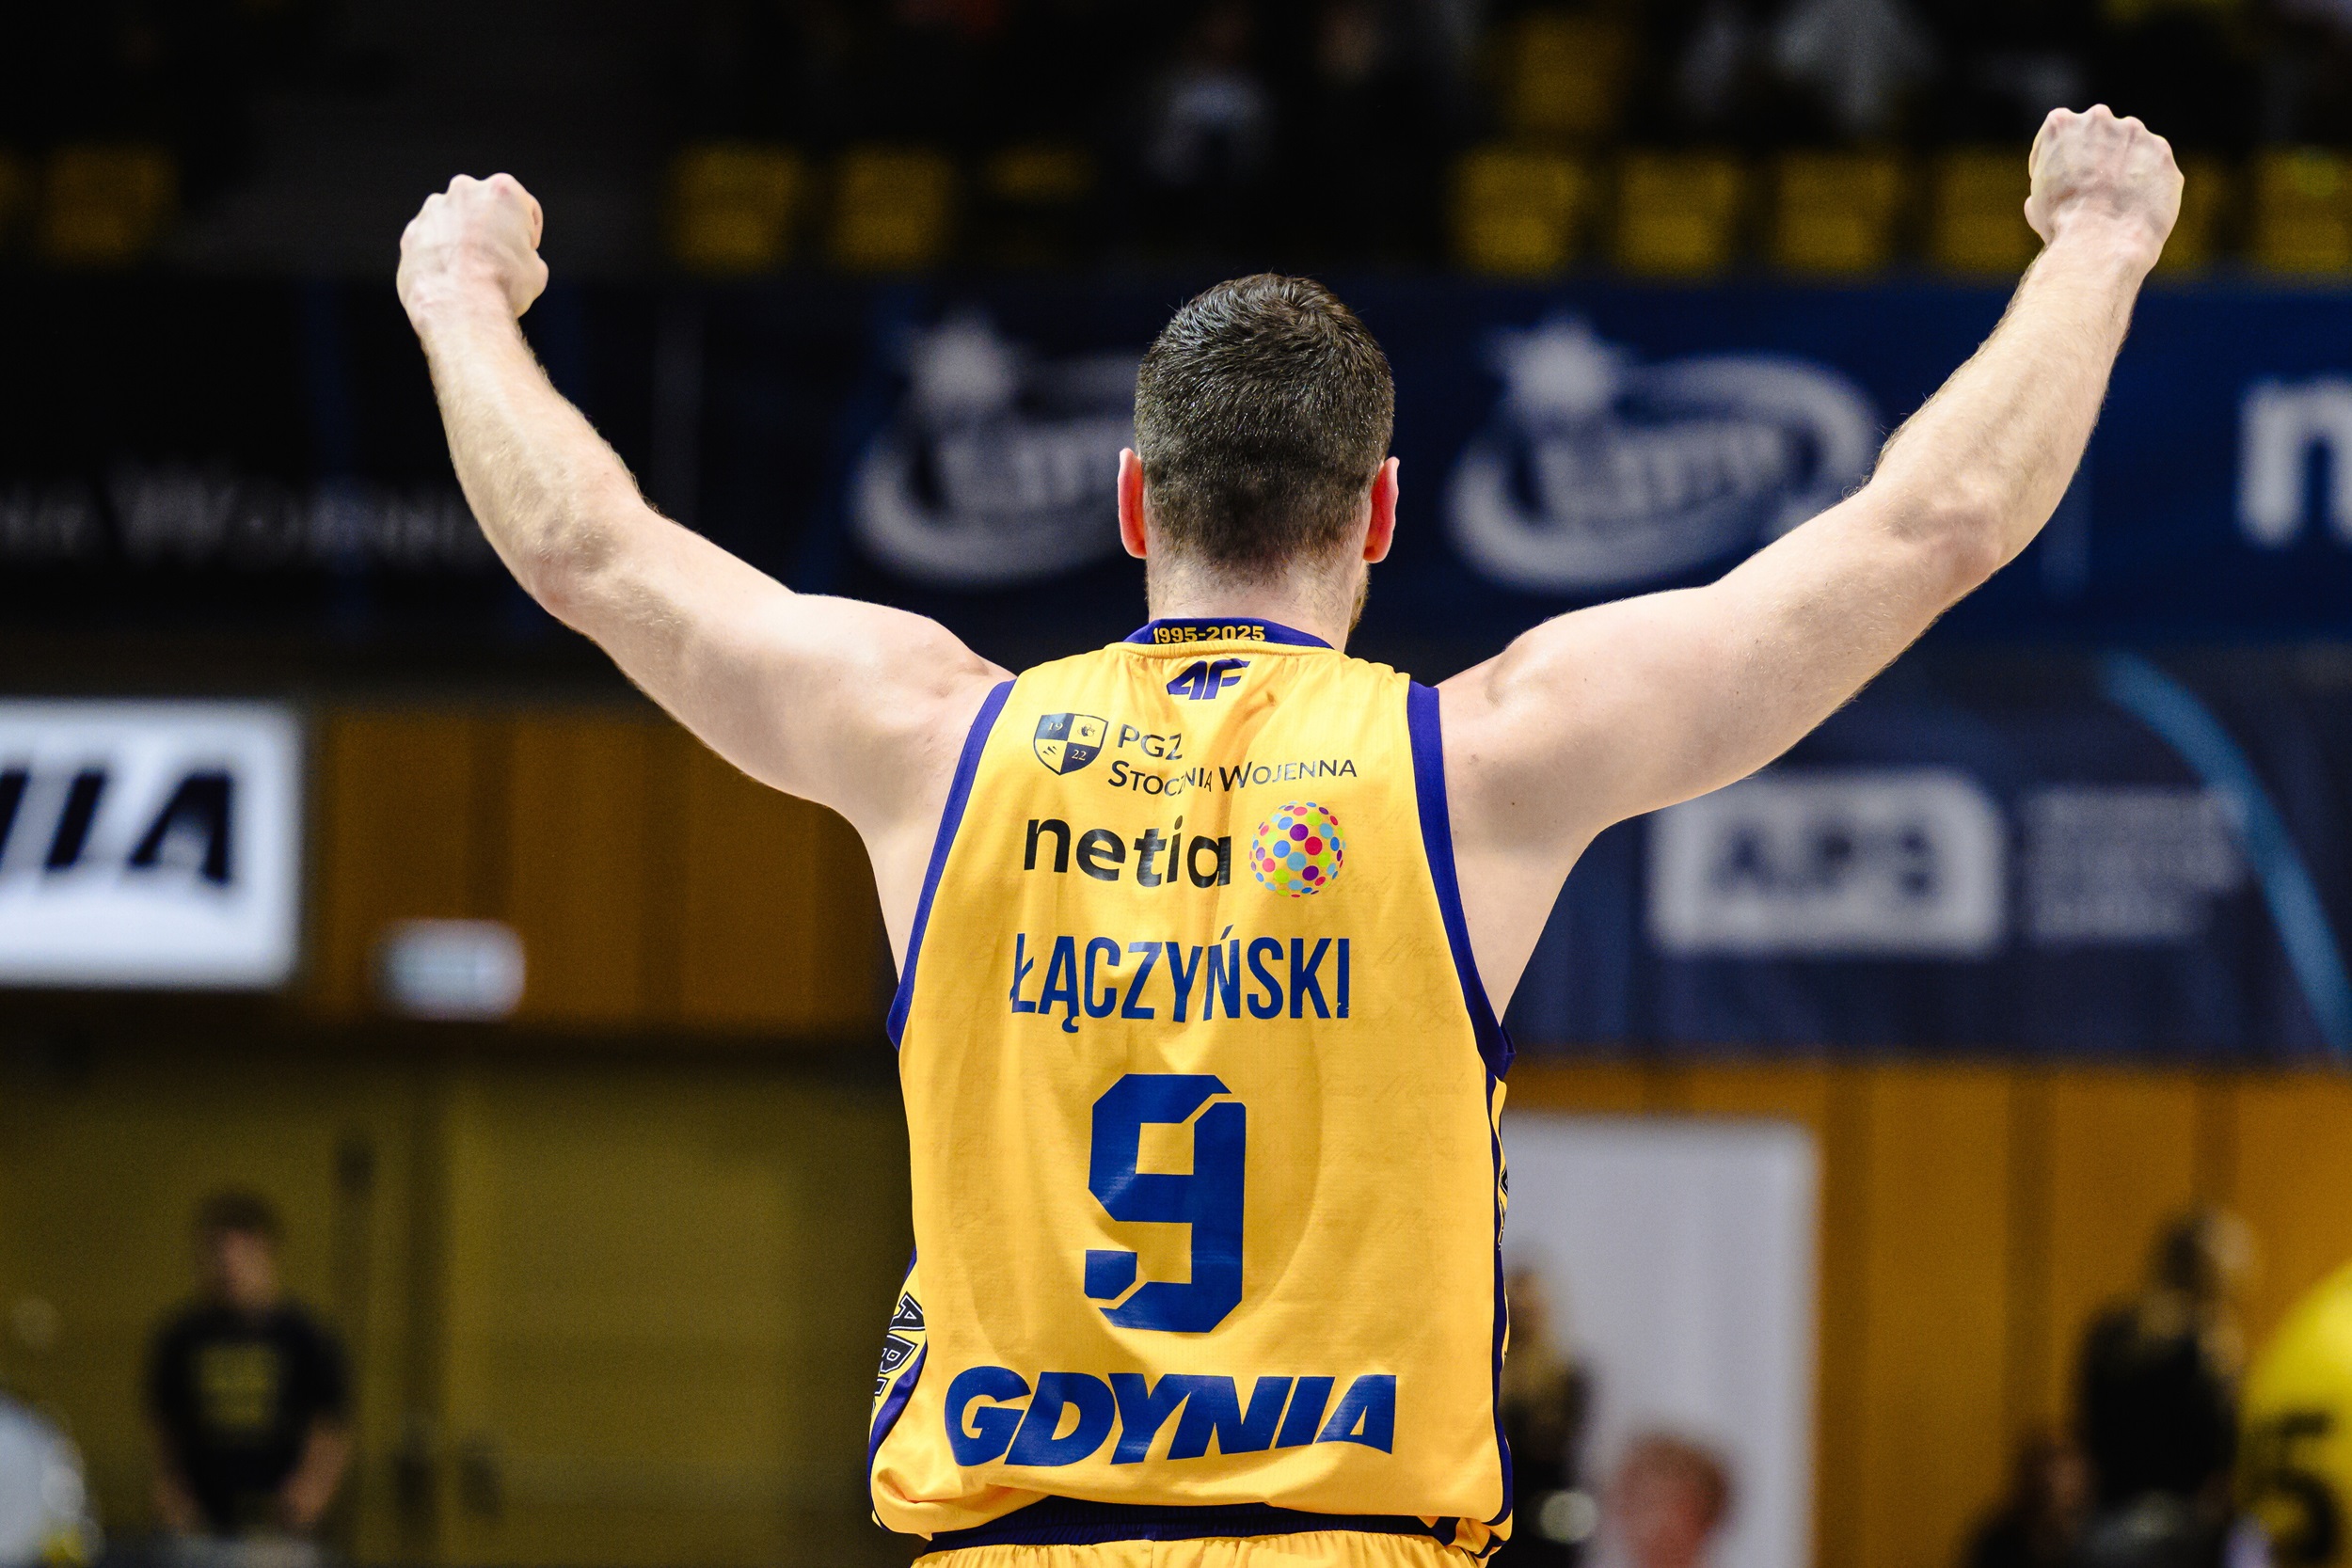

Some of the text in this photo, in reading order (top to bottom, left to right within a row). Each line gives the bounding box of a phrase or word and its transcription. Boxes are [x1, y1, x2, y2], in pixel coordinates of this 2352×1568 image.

[1153, 626, 1264, 643] 1995-2025
[1167, 658, 1250, 700] 4F
[1047, 721, 1064, 732] 19
[1118, 723, 1183, 760] PGZ
[1071, 749, 1087, 762] 22
[1218, 759, 1357, 792] WOJENNA
[1024, 816, 1232, 887] netia
[1009, 925, 1350, 1033] ŁĄCZYŃSKI
[1084, 1073, 1247, 1333] 9
[944, 1366, 1397, 1467] GDYNIA
